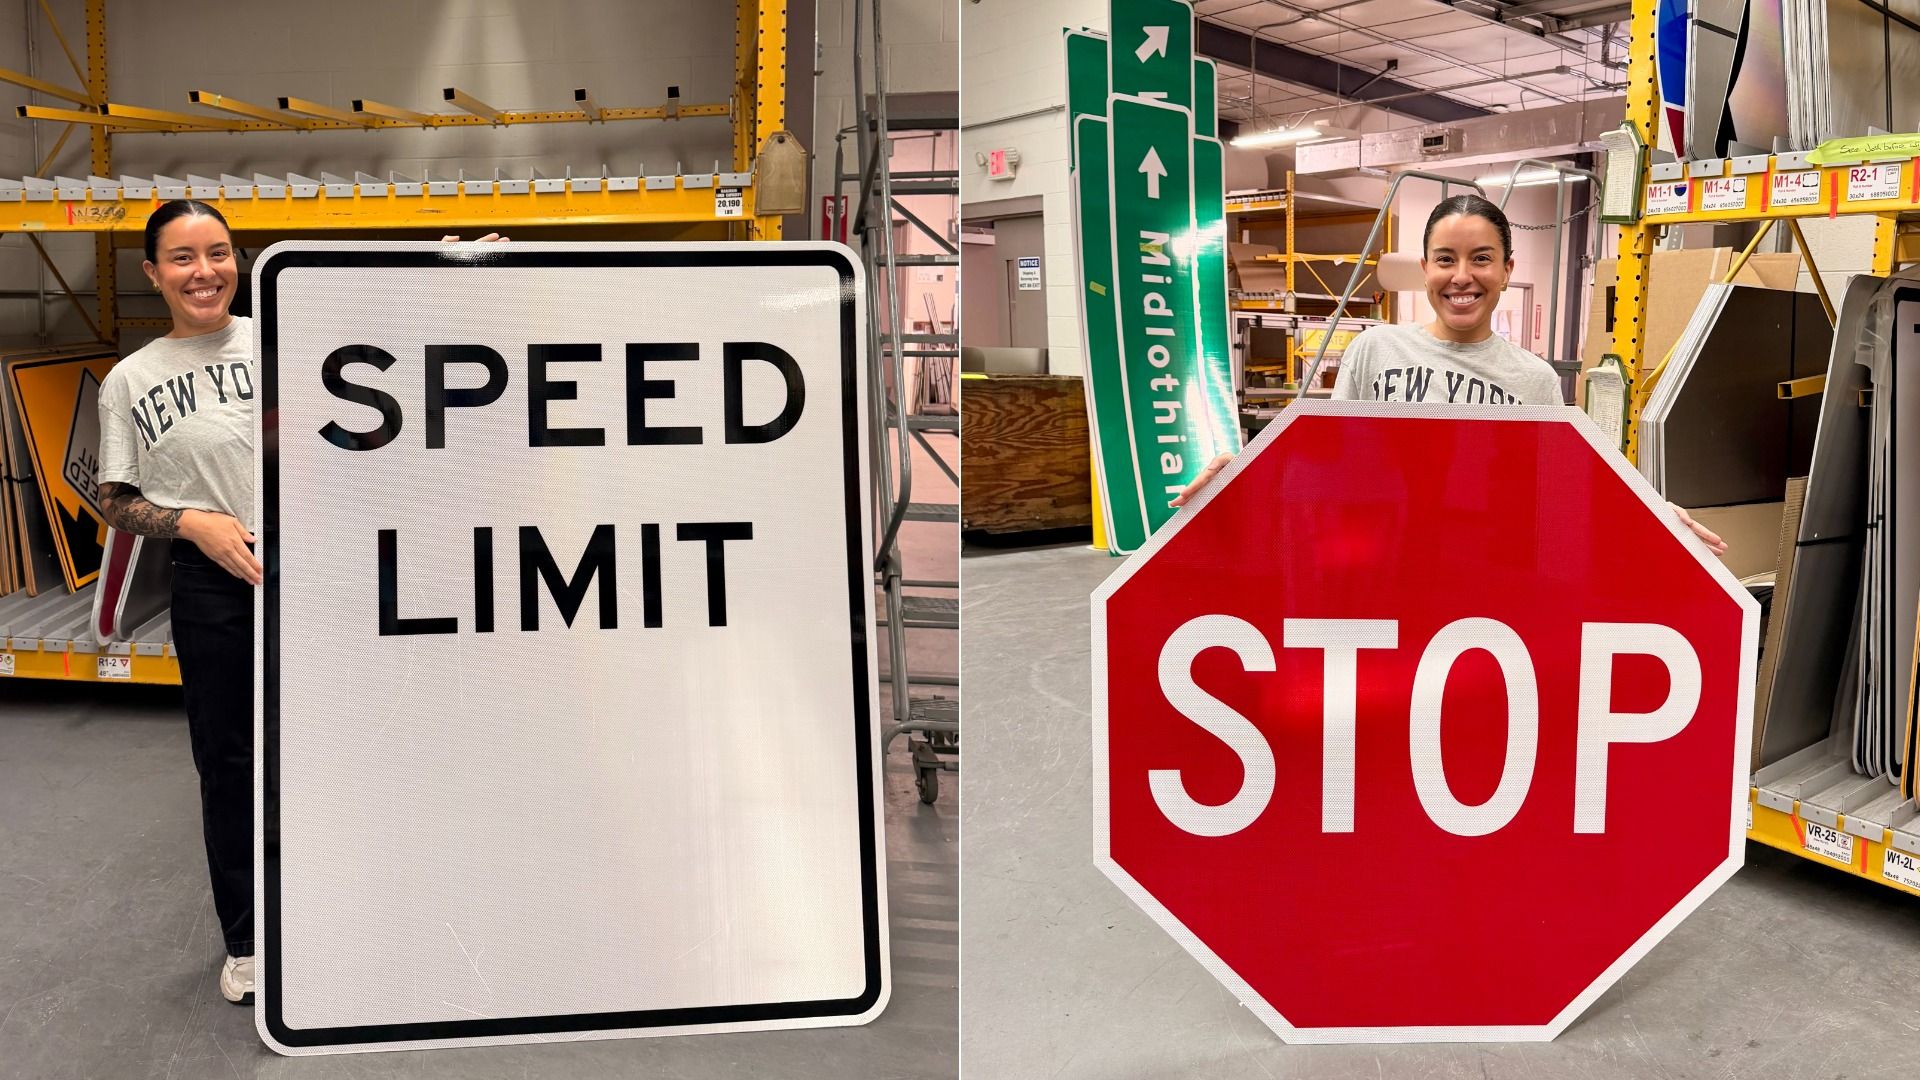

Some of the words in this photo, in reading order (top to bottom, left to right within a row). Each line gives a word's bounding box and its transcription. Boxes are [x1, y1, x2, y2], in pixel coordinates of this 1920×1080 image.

[1774, 174, 1802, 189] M1-4
[1850, 167, 1878, 183] R2-1
[1648, 185, 1672, 199] M1-1
[1704, 179, 1731, 194] M1-4
[717, 199, 741, 208] 20,190
[1020, 259, 1040, 267] NOTICE
[318, 341, 806, 452] SPEED
[1445, 370, 1523, 405] YOR
[131, 371, 197, 452] NEW
[204, 360, 254, 404] YO
[70, 462, 99, 502] EED
[378, 521, 753, 636] LIMIT
[98, 657, 117, 667] R1-2
[1148, 614, 1702, 837] STOP
[1807, 823, 1837, 843] VR-25
[1887, 850, 1915, 871] W1-2L
